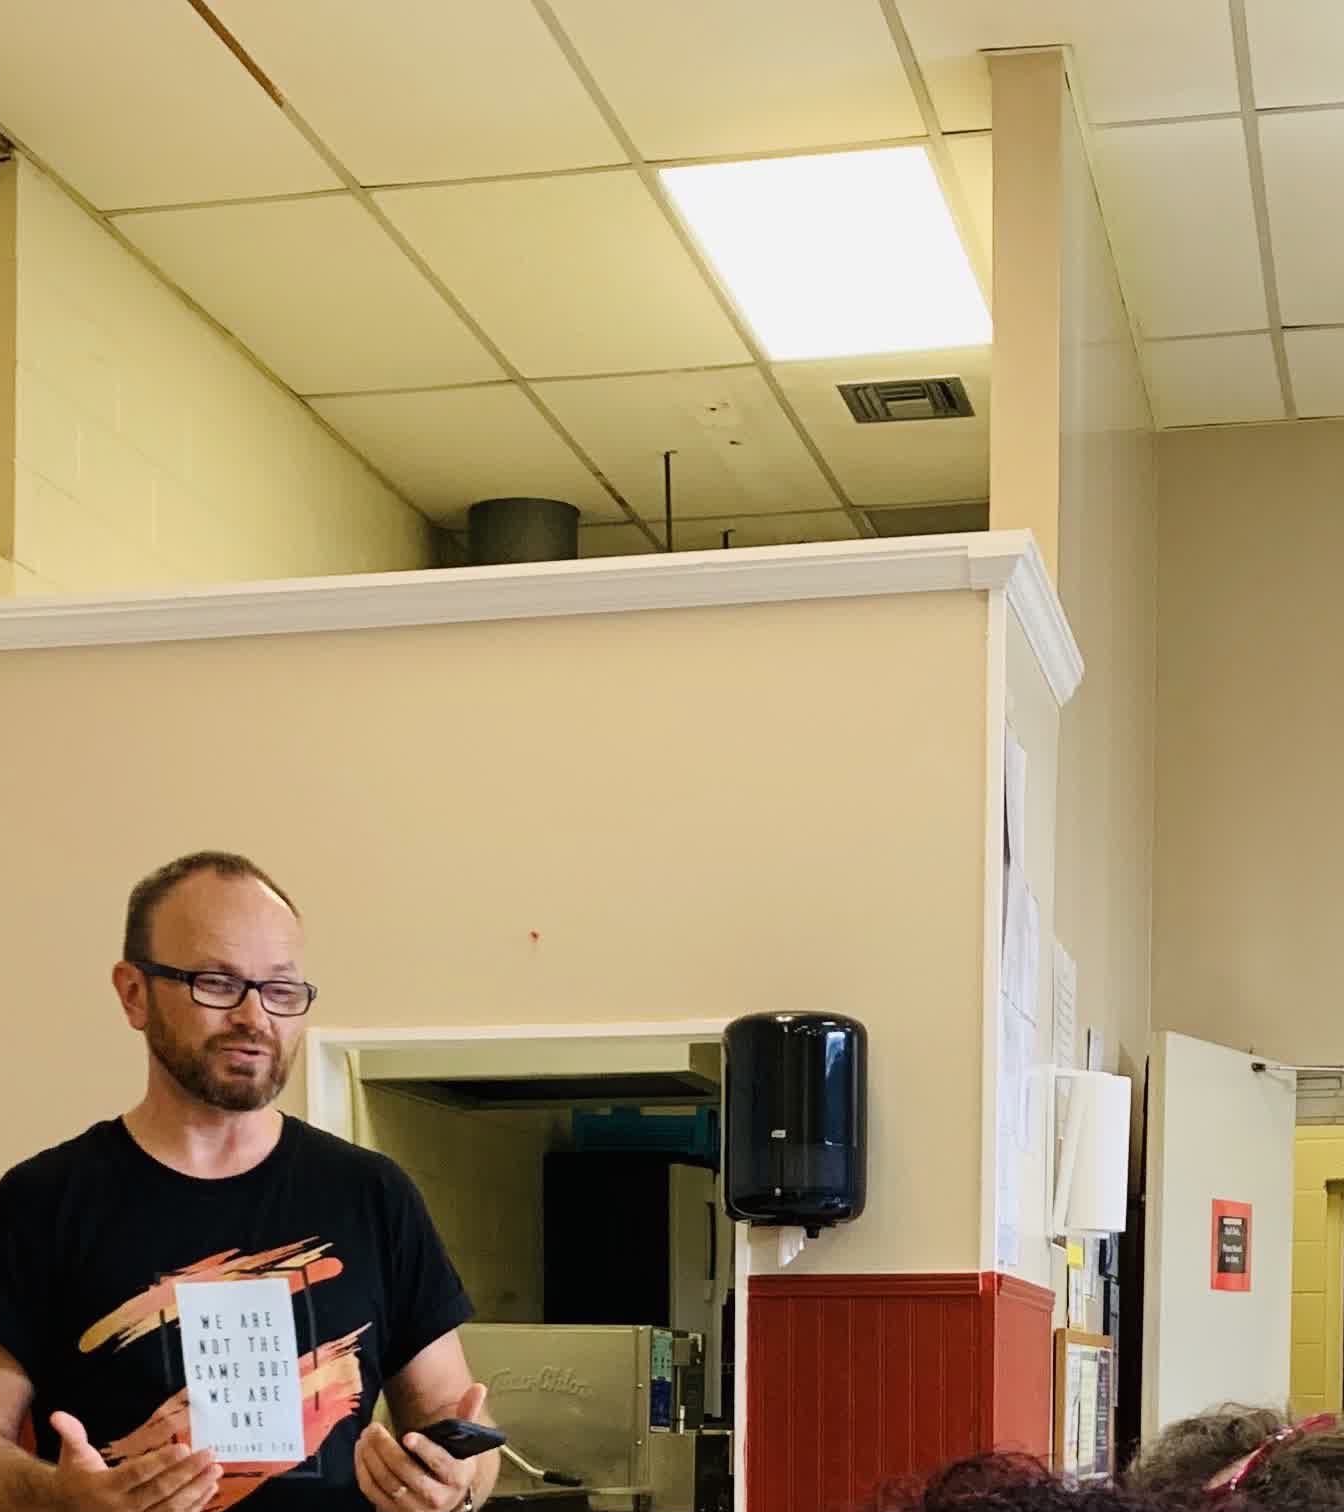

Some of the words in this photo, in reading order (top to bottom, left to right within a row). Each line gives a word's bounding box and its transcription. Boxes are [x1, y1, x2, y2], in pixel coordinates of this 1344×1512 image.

[200, 1314, 224, 1330] WE
[240, 1312, 272, 1329] ARE
[199, 1338, 231, 1355] NOT
[248, 1335, 281, 1353] THE
[194, 1362, 240, 1380] SAME
[258, 1360, 289, 1377] BUT
[209, 1387, 233, 1404] WE
[248, 1385, 281, 1402] ARE
[231, 1411, 264, 1429] ONE
